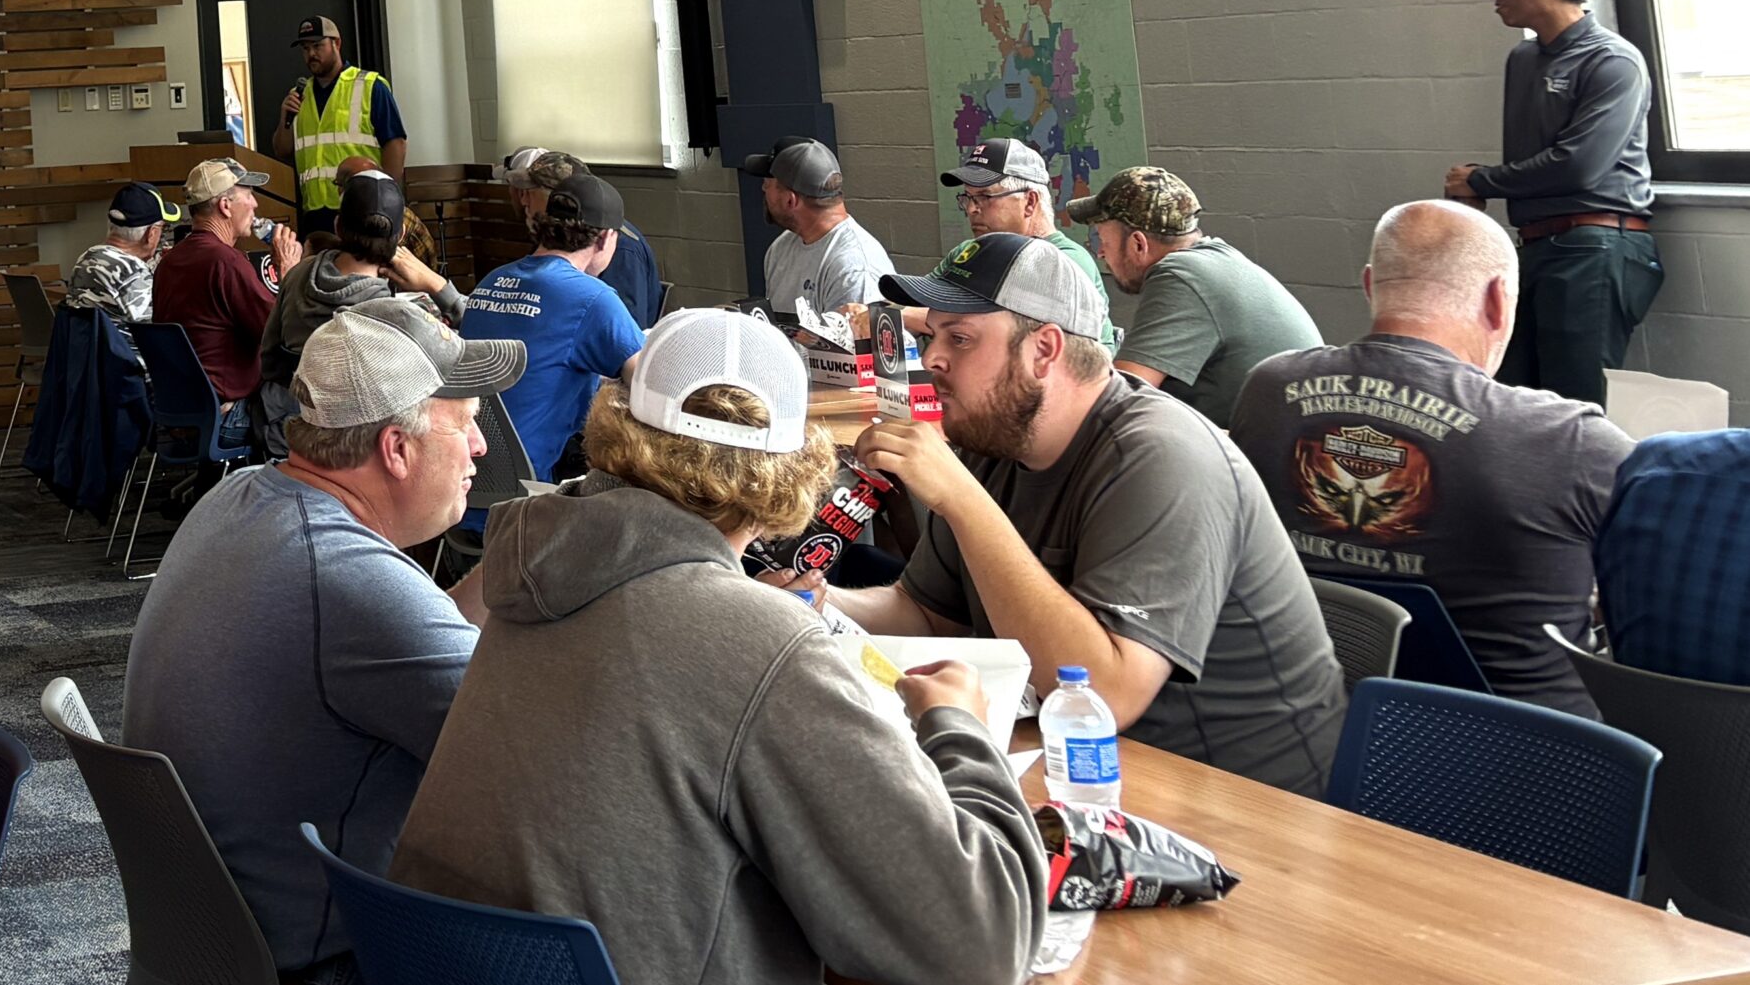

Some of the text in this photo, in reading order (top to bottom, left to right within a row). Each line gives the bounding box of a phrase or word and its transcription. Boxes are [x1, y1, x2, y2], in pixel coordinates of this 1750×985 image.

[492, 290, 519, 300] COUNTY
[519, 292, 541, 304] FAIR
[494, 276, 521, 289] 2021
[820, 358, 858, 375] LUNCH
[1284, 374, 1481, 435] SAUK PRAIRIE
[1300, 393, 1452, 442] HARLEY-DAVIDSON
[832, 486, 876, 524] CHIP
[1336, 542, 1391, 573] CITY,
[1392, 551, 1426, 576] WI
